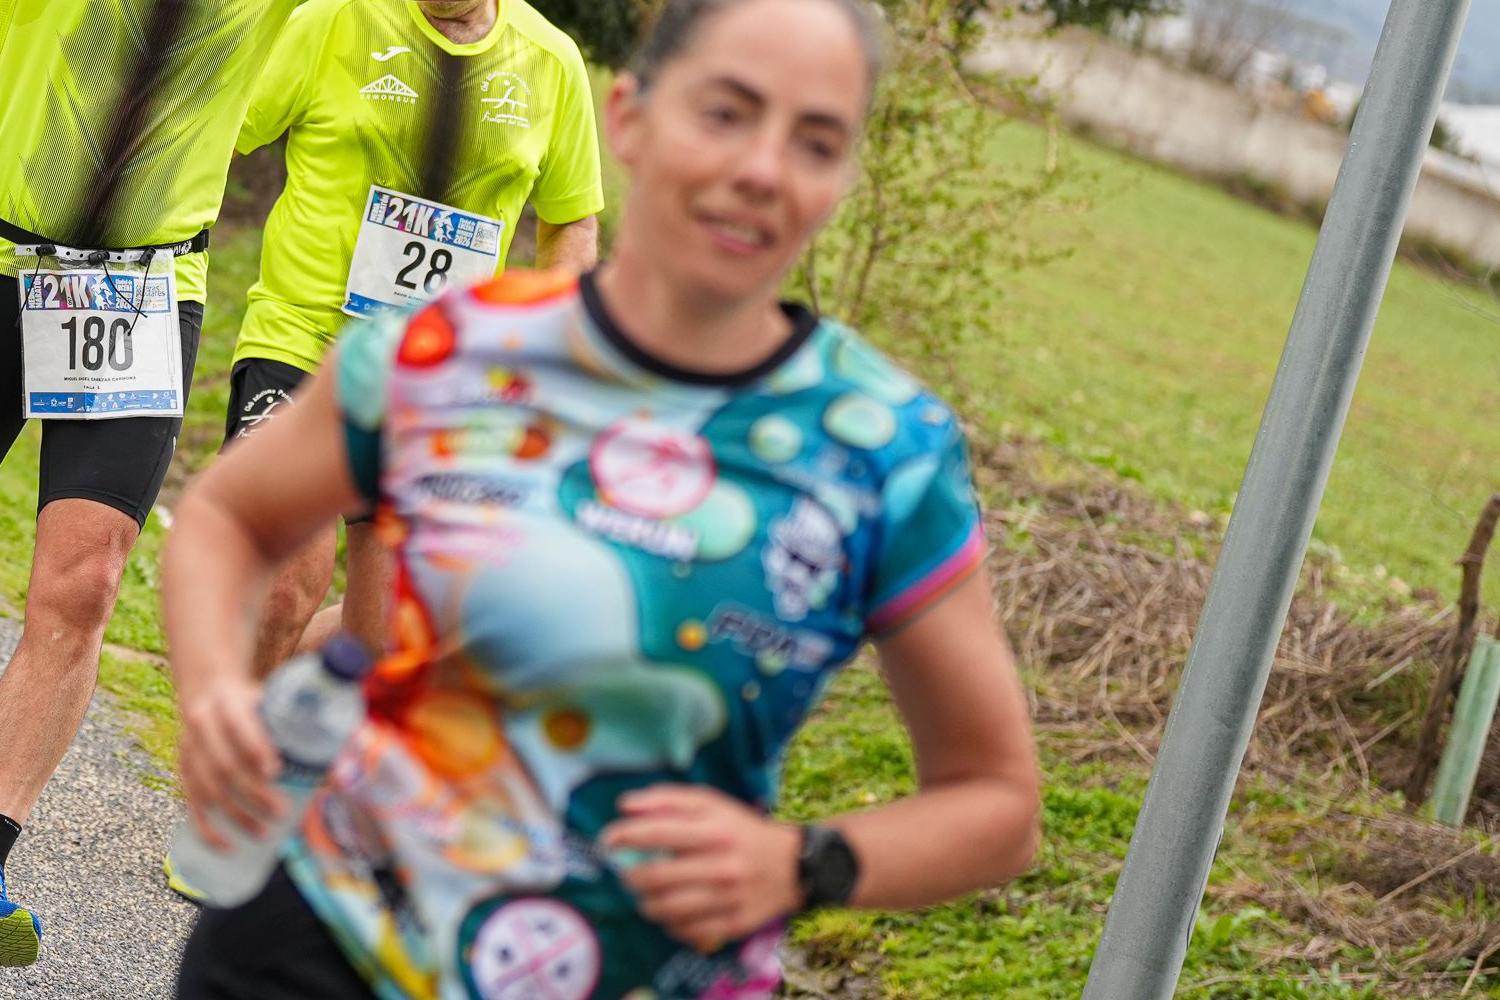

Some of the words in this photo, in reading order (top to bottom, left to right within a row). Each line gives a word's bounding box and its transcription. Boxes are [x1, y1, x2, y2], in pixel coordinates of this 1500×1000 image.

[384, 197, 435, 238] 21K
[395, 241, 453, 294] 28
[44, 275, 90, 308] 21K
[61, 316, 134, 371] 180
